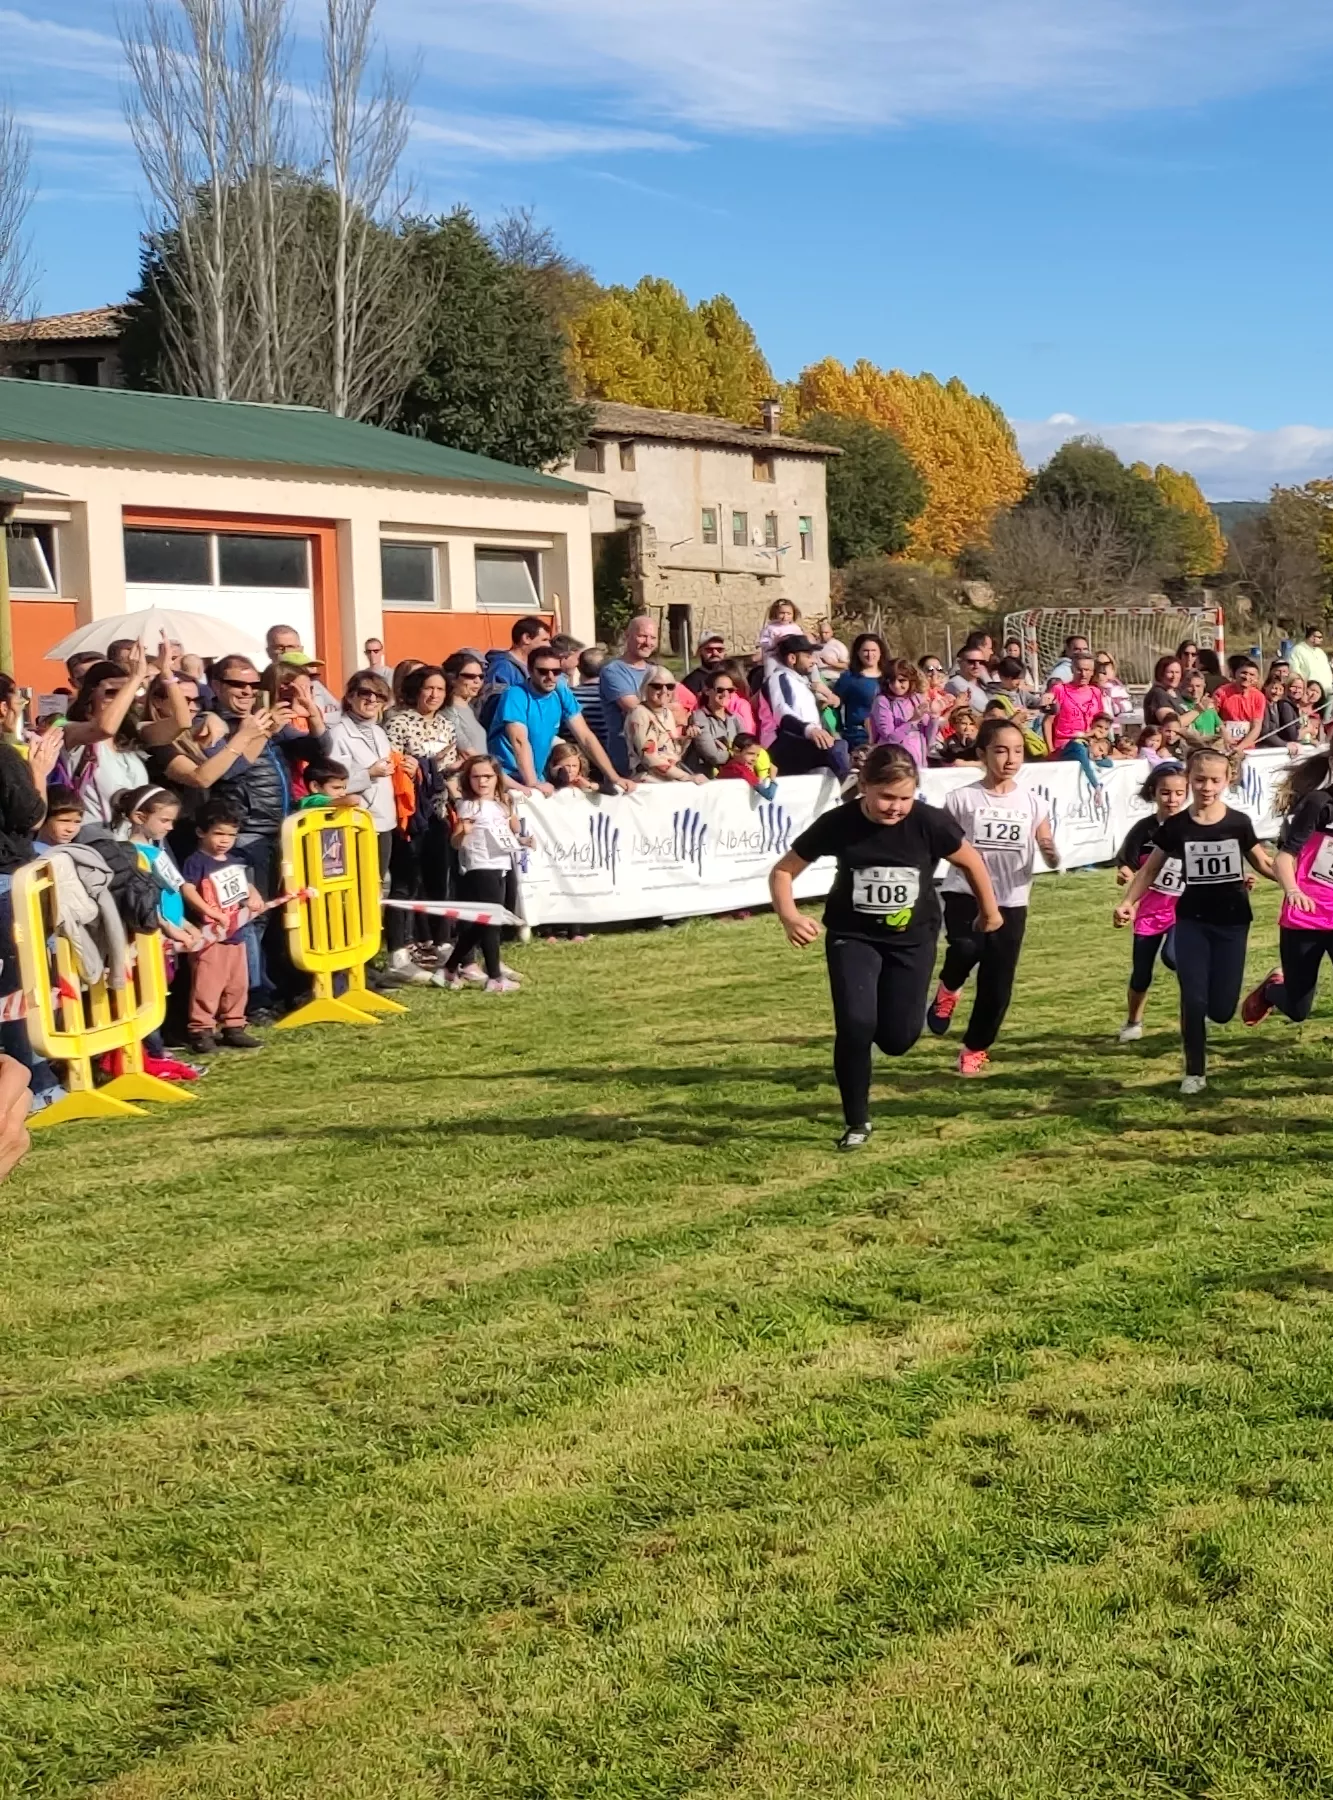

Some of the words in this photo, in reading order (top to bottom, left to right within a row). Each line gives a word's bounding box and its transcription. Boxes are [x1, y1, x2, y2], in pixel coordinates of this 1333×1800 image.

[983, 822, 1021, 841] 128
[1195, 855, 1232, 876] 101
[863, 884, 908, 904] 108
